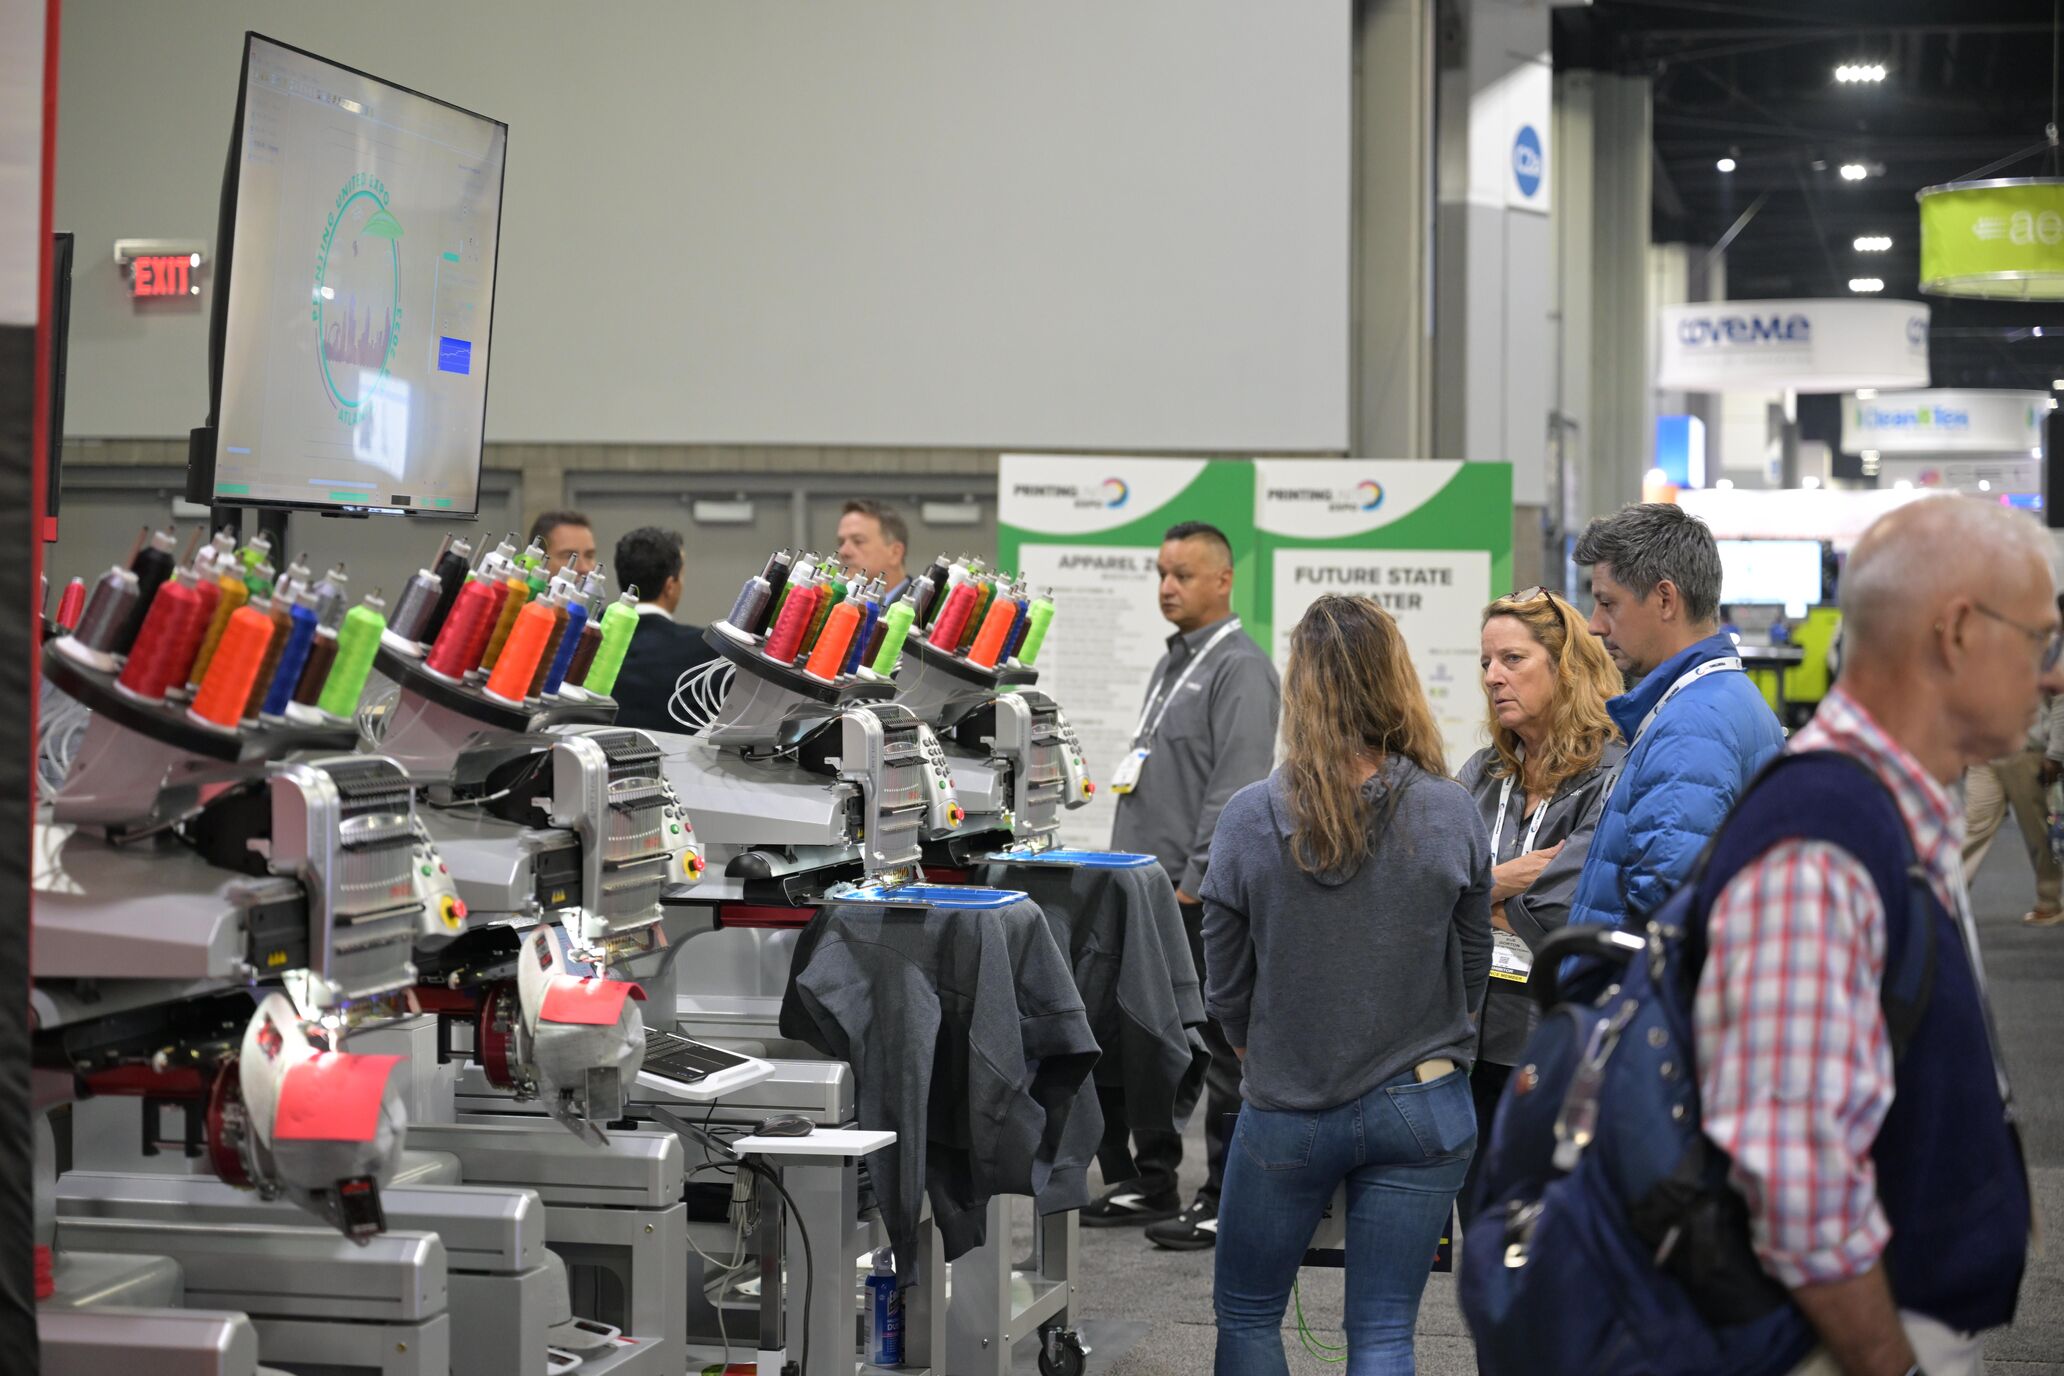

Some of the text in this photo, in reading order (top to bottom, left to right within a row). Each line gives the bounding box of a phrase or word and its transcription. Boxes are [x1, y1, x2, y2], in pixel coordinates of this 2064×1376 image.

[311, 211, 335, 321] PRNTING
[135, 256, 189, 295] EXIT
[1013, 484, 1078, 498] PRINTING
[1267, 488, 1333, 501] PRINTING
[1058, 555, 1137, 571] APPAREL
[1295, 566, 1454, 586] FUTURE STATE
